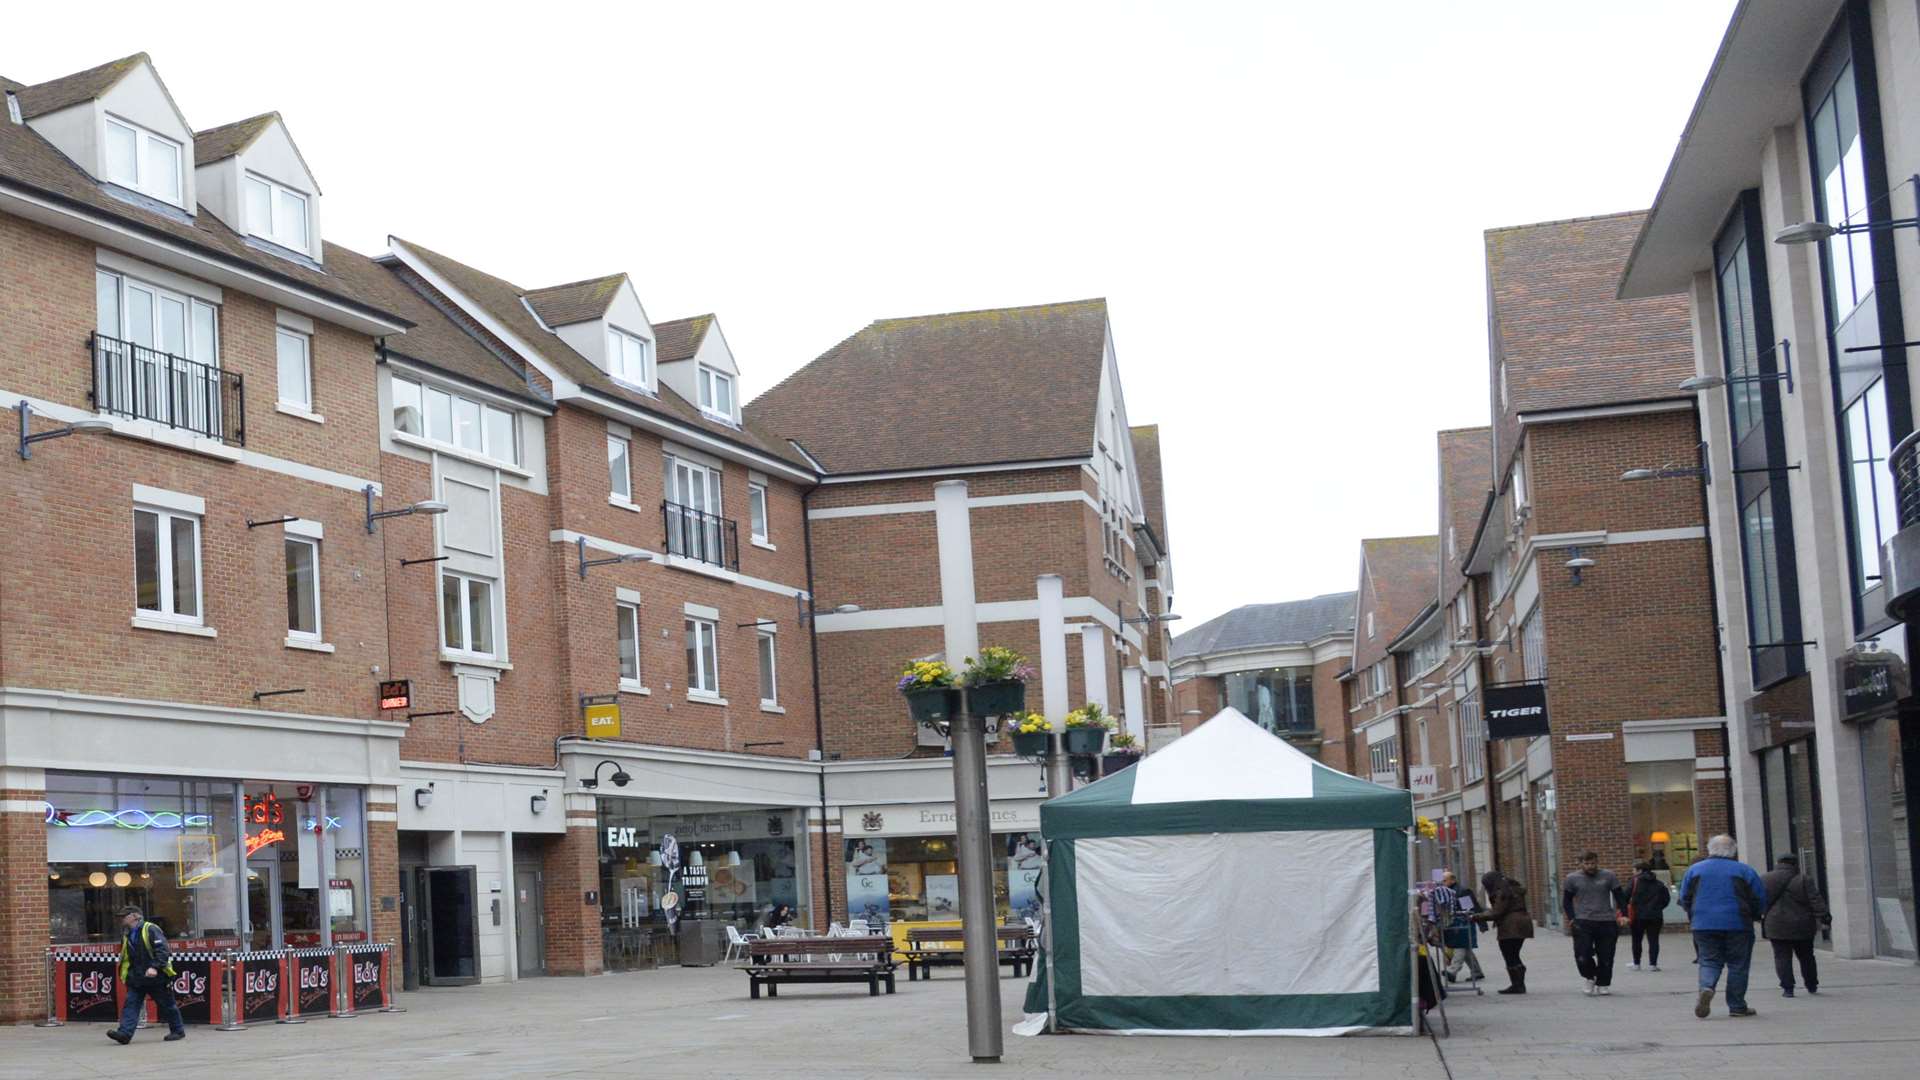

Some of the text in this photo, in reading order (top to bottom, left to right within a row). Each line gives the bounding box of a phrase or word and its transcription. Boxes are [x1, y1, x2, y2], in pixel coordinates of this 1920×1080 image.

[591, 716, 615, 726] EAT.
[1490, 706, 1543, 719] TIGER
[607, 826, 639, 847] EAT.
[70, 971, 113, 994] Ed's
[172, 970, 207, 994] d's
[245, 969, 278, 994] Ed's
[300, 965, 329, 989] Ed's
[354, 961, 380, 984] Ed's
